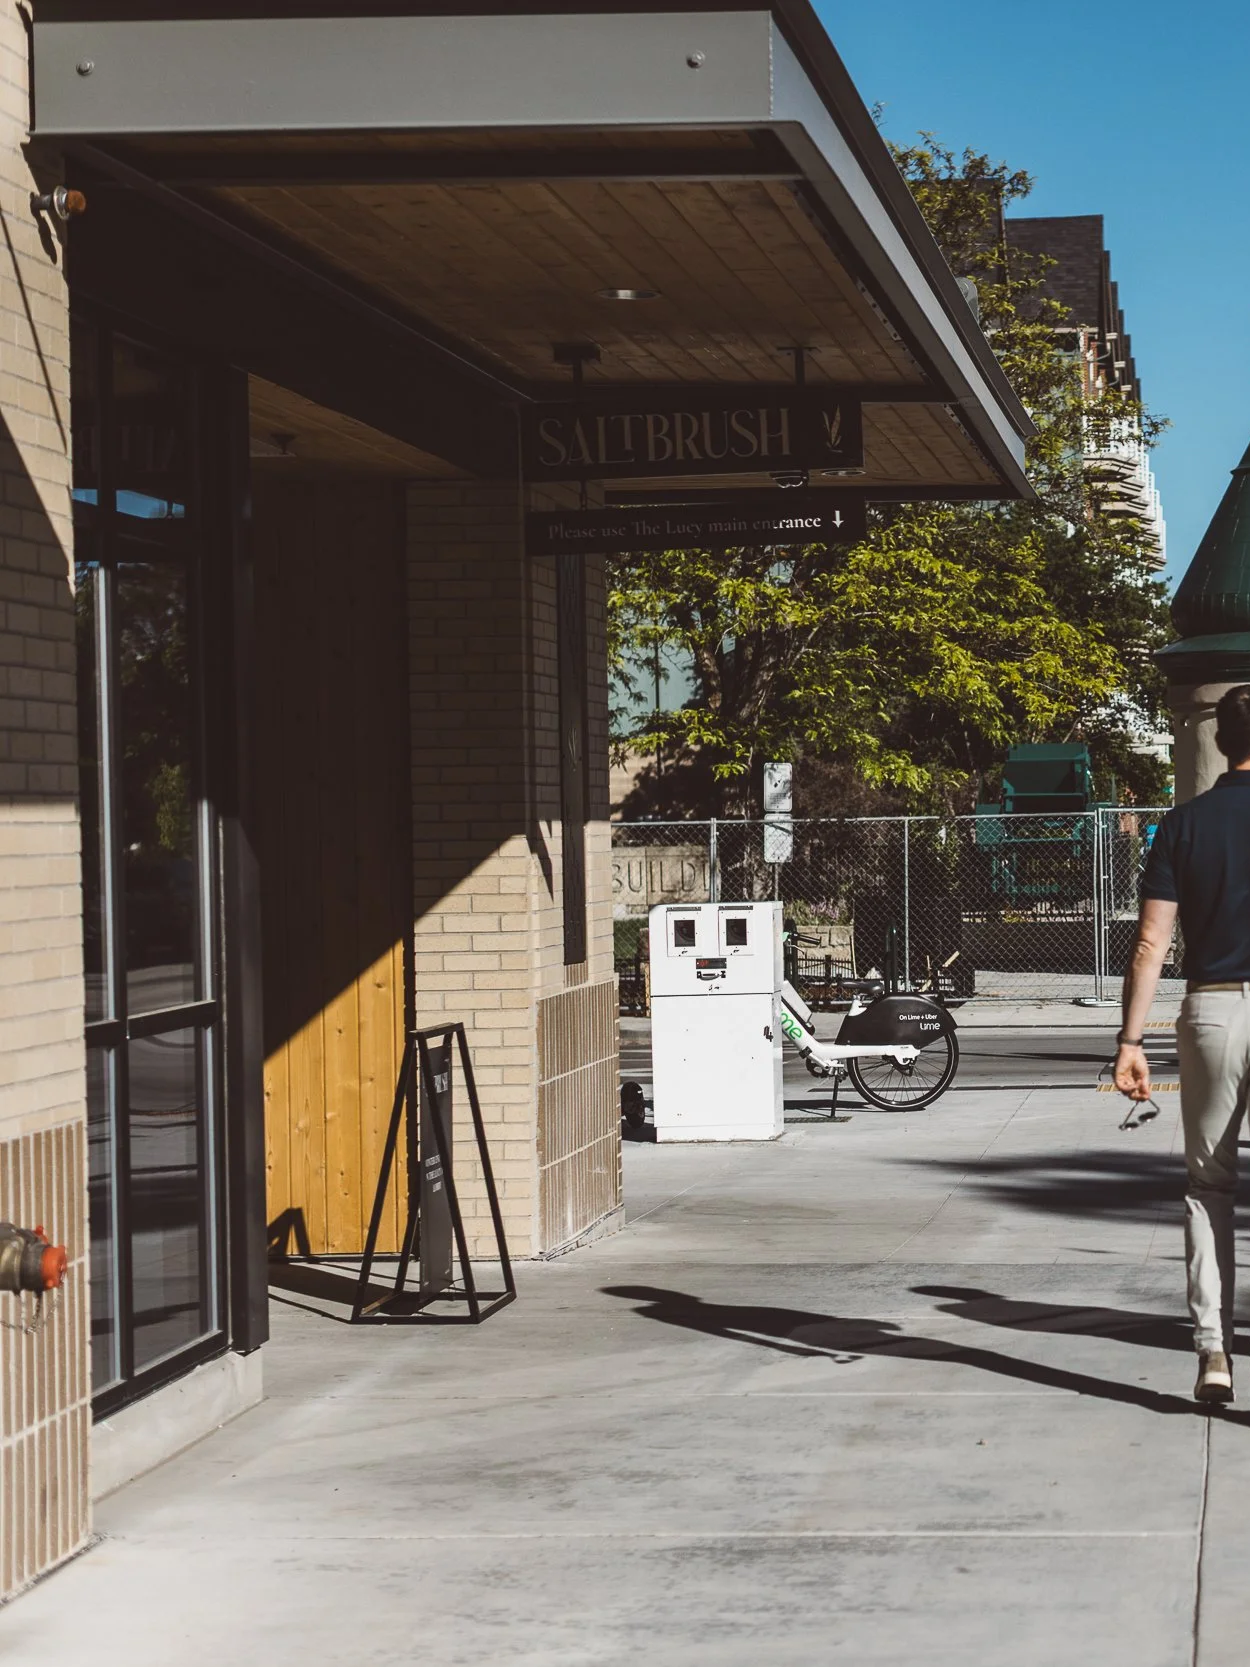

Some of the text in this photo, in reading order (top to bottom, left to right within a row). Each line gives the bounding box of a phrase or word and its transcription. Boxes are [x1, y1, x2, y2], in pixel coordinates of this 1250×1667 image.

[539, 408, 792, 467] SALTBRUSH
[548, 516, 822, 540] Please use The Lucy main entrance
